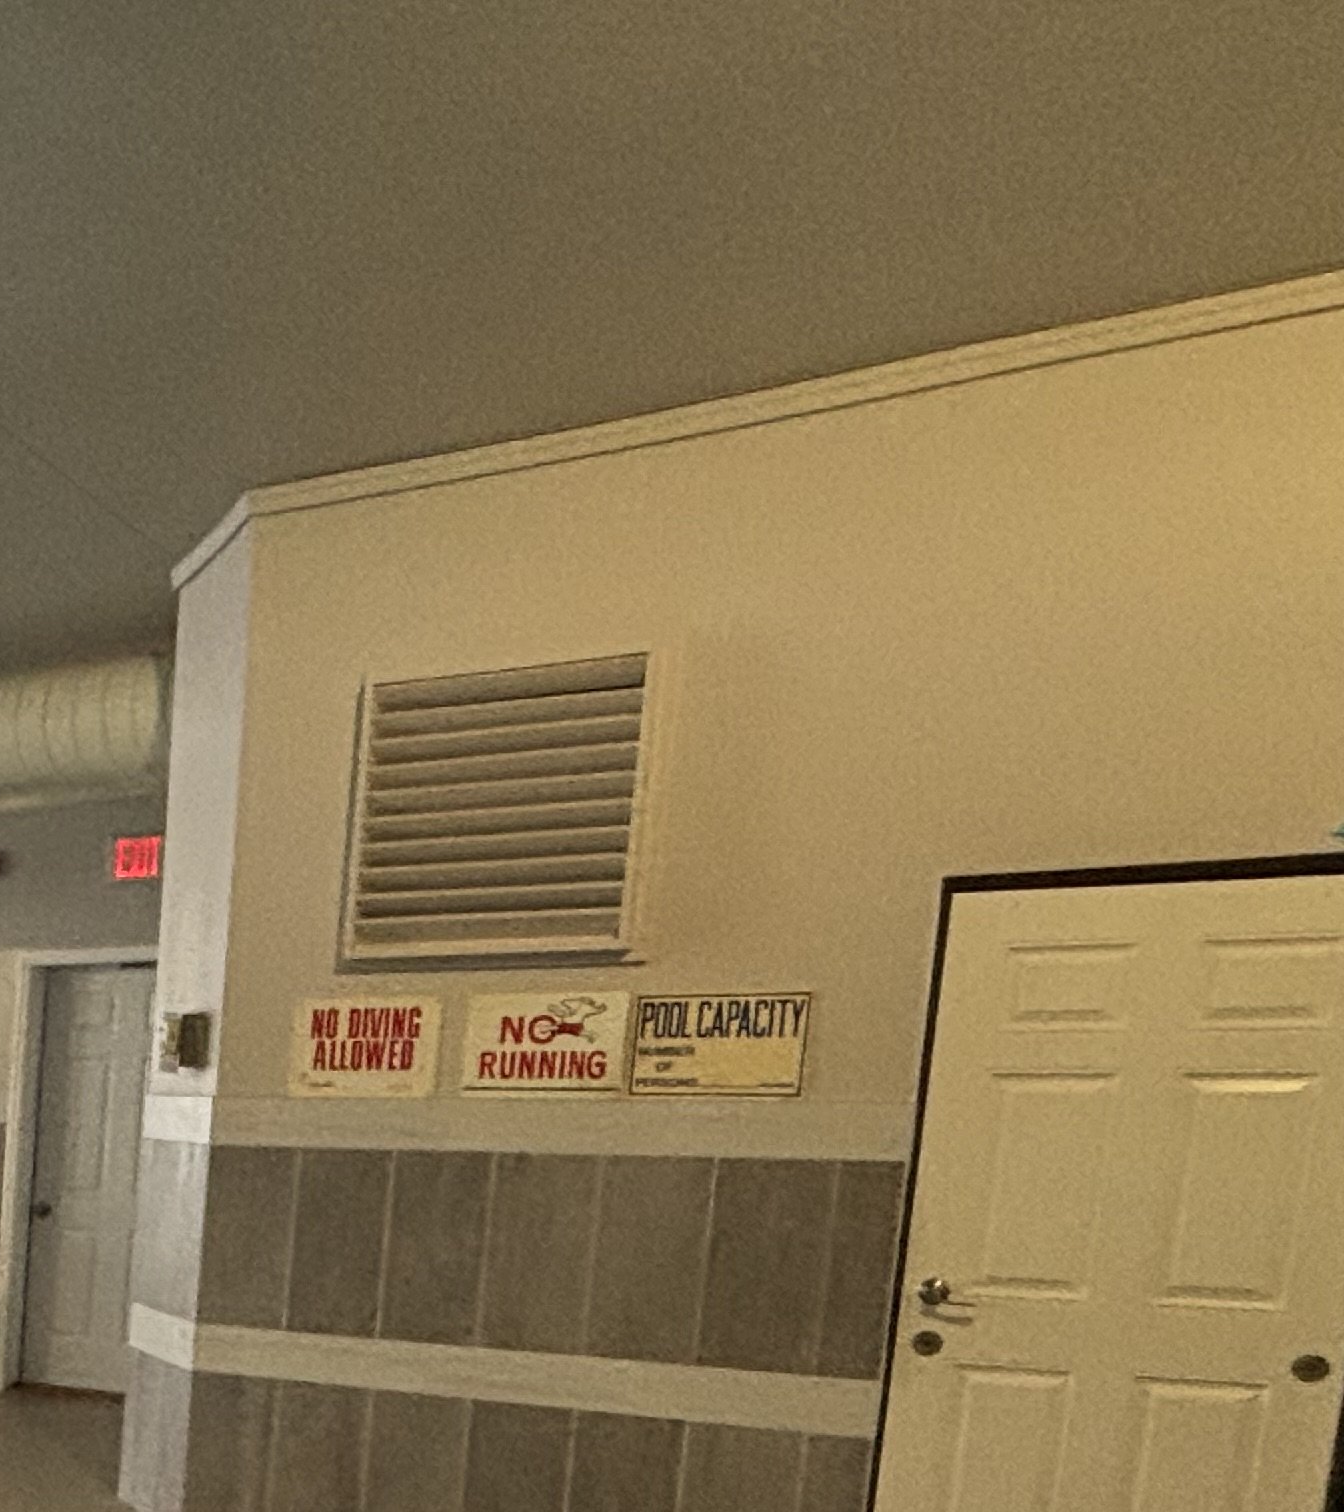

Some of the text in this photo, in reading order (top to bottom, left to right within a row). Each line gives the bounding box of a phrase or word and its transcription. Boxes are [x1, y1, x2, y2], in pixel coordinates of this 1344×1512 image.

[311, 1007, 422, 1039] NO DIVING
[500, 1015, 556, 1044] NO
[641, 999, 804, 1039] POOL CAPACITY
[313, 1040, 414, 1071] ALLOWED
[478, 1050, 607, 1079] RUNNING
